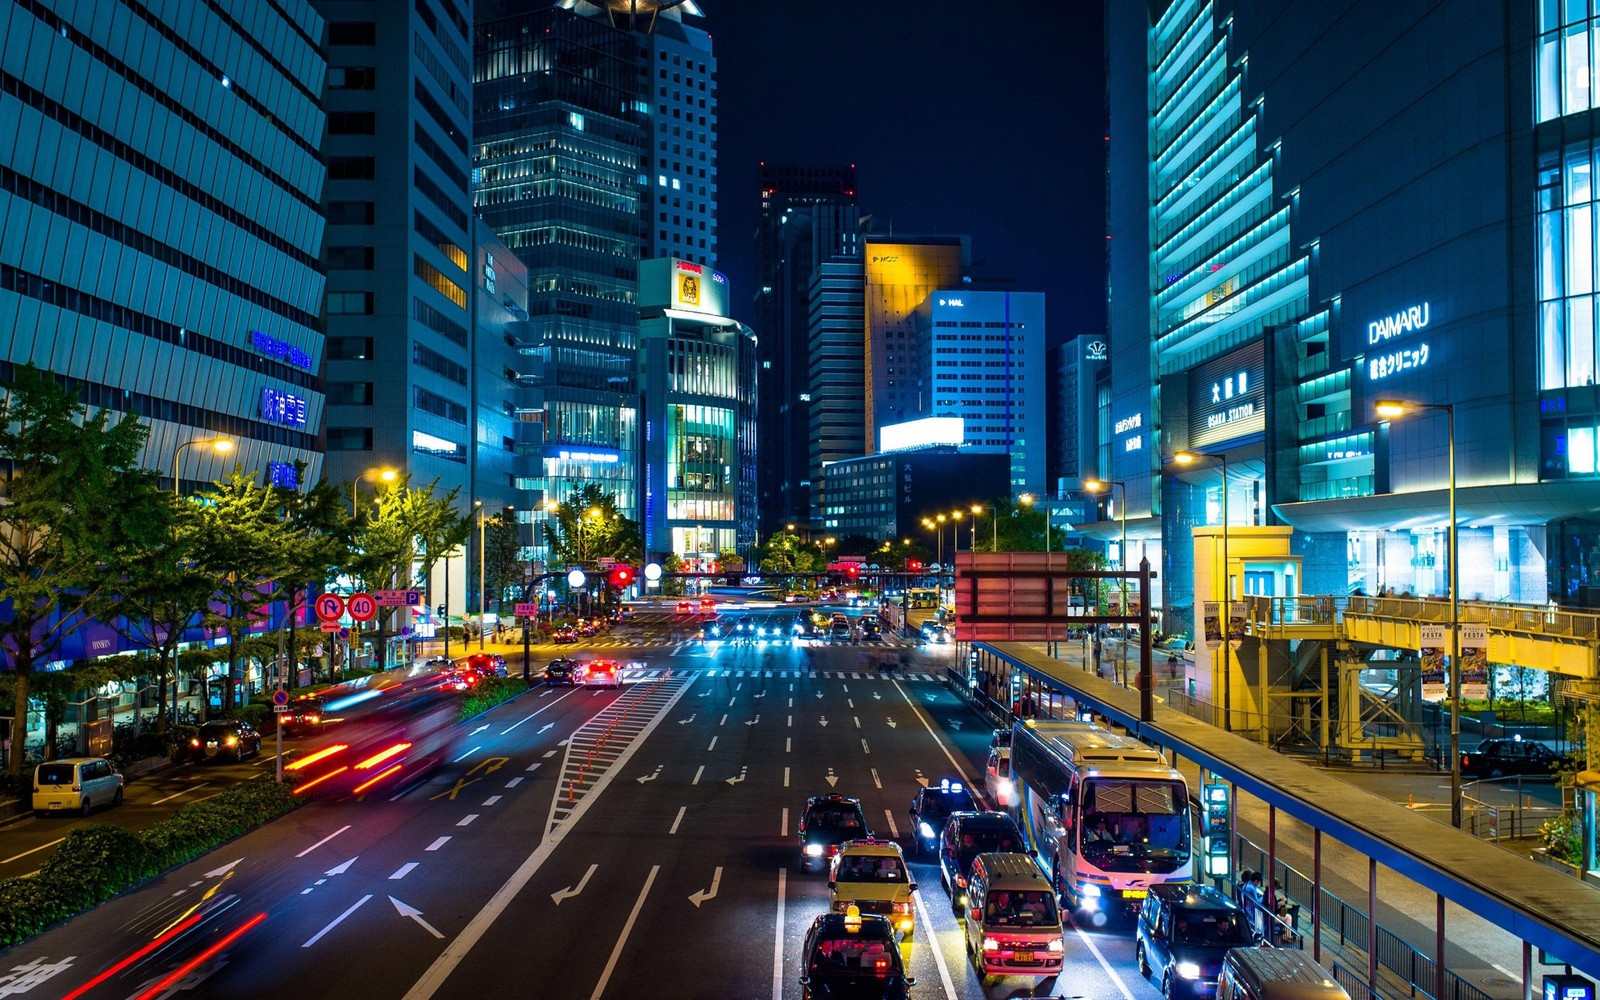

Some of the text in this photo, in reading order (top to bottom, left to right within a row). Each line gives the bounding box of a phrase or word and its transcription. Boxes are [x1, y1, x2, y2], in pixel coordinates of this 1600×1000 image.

[948, 299, 964, 307] HAL
[1368, 301, 1430, 345] DAIMARU
[264, 388, 306, 428] 阪神電車
[1207, 402, 1254, 429] OSAKA STATION
[354, 601, 370, 614] 40
[410, 593, 417, 604] P
